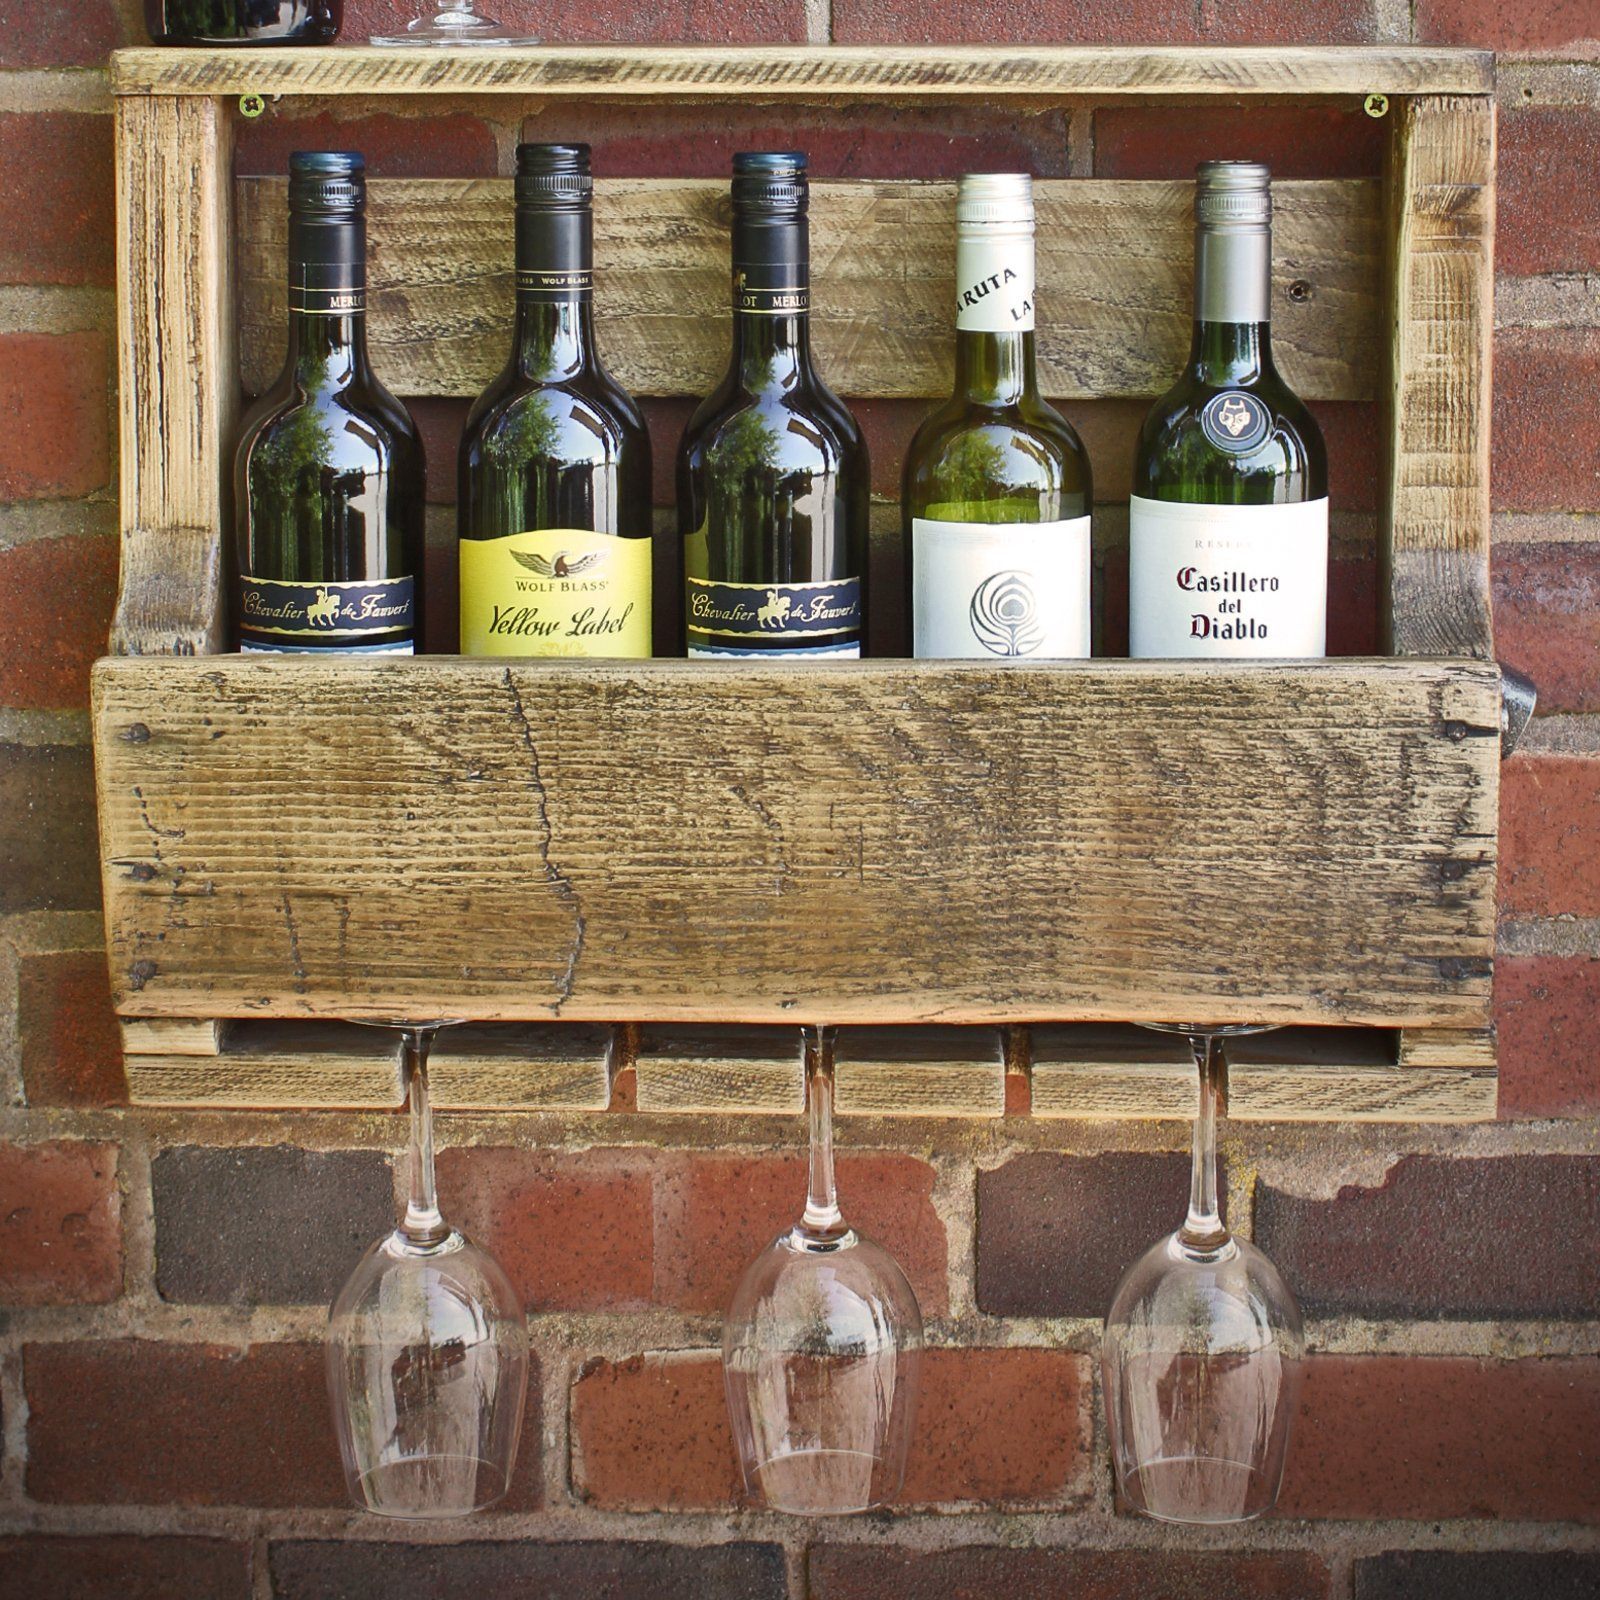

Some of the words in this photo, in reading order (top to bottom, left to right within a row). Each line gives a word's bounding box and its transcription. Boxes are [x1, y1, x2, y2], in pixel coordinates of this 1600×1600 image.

[541, 277, 566, 285] WOLF
[772, 295, 808, 308] MERLO
[515, 581, 556, 592] WOLF
[560, 581, 606, 592] BLASS
[1176, 566, 1280, 592] Casillero
[242, 590, 305, 619] Chevalier
[340, 602, 352, 616] de
[692, 592, 755, 621] Chevalier
[790, 604, 802, 618] de
[1218, 599, 1242, 613] del
[488, 604, 561, 636] Yellow
[565, 602, 634, 637] Label
[1189, 613, 1268, 640] Diablo
